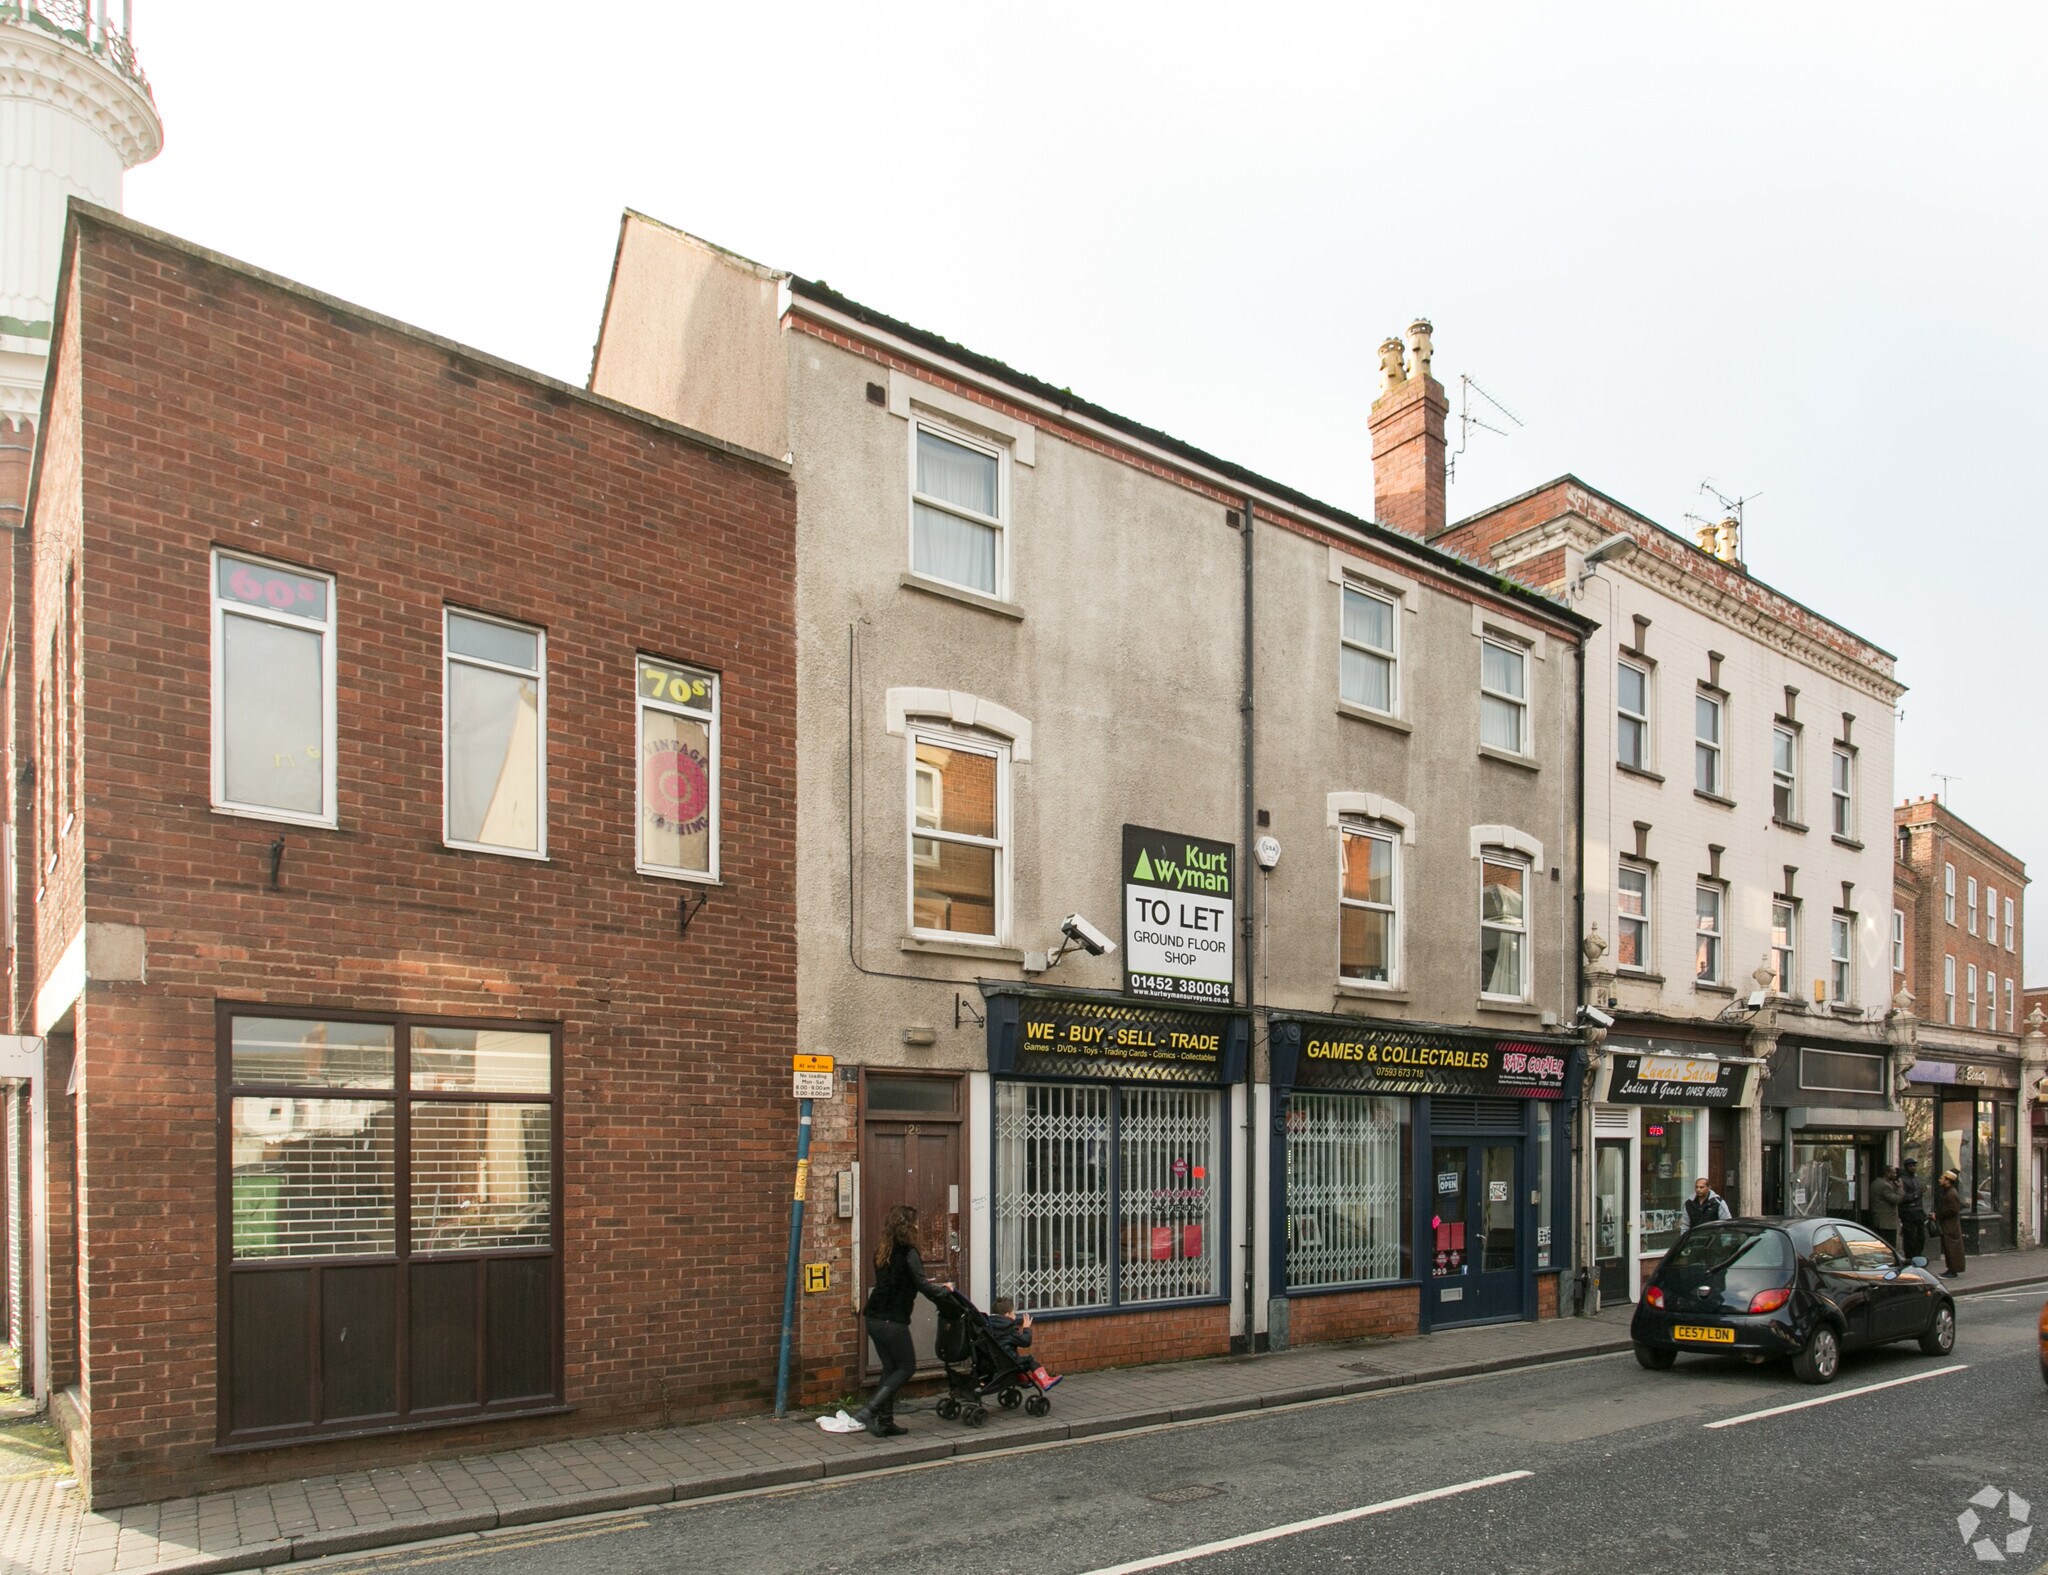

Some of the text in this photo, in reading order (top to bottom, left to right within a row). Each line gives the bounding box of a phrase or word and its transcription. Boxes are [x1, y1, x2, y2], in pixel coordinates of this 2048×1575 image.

[230, 568, 316, 609] 60s
[645, 668, 706, 703] 70s
[643, 739, 708, 769] VINTAGE
[643, 807, 708, 836] CLOTHING
[1186, 844, 1228, 873] Kurt
[1154, 858, 1229, 893] Wyman
[1135, 897, 1224, 933] TO LET
[1133, 930, 1226, 953] GROUND FLOOR
[1164, 951, 1197, 965] SHOP
[1131, 974, 1230, 997] 01452 380064
[1133, 989, 1230, 1004] www.kurtwymansurveyors.co.uk
[1027, 1022, 1055, 1039] WE
[1069, 1025, 1105, 1043] BUY
[1117, 1028, 1156, 1046] SELL
[1170, 1032, 1219, 1050] TRADE
[1023, 1042, 1050, 1052] Games
[1056, 1044, 1077, 1053] DVDs
[1083, 1046, 1098, 1056] Toys
[1104, 1047, 1127, 1057] Trading
[1128, 1049, 1147, 1057] Cards
[1152, 1050, 1176, 1059] Comics
[1180, 1052, 1216, 1062] Collectables
[1307, 1040, 1489, 1068] GAMES & COLLECTABLES
[1376, 1067, 1424, 1078] 07593 673 718
[1503, 1053, 1564, 1080] KATS CORNER
[1638, 1057, 1718, 1082] Luna's Salon
[1619, 1080, 1648, 1094] Ladies
[1650, 1081, 1658, 1094] &
[1660, 1082, 1683, 1099] Gents
[904, 1124, 922, 1135] 126
[1440, 1181, 1456, 1190] OPEN
[1679, 1327, 1729, 1340] CE57 LDN
